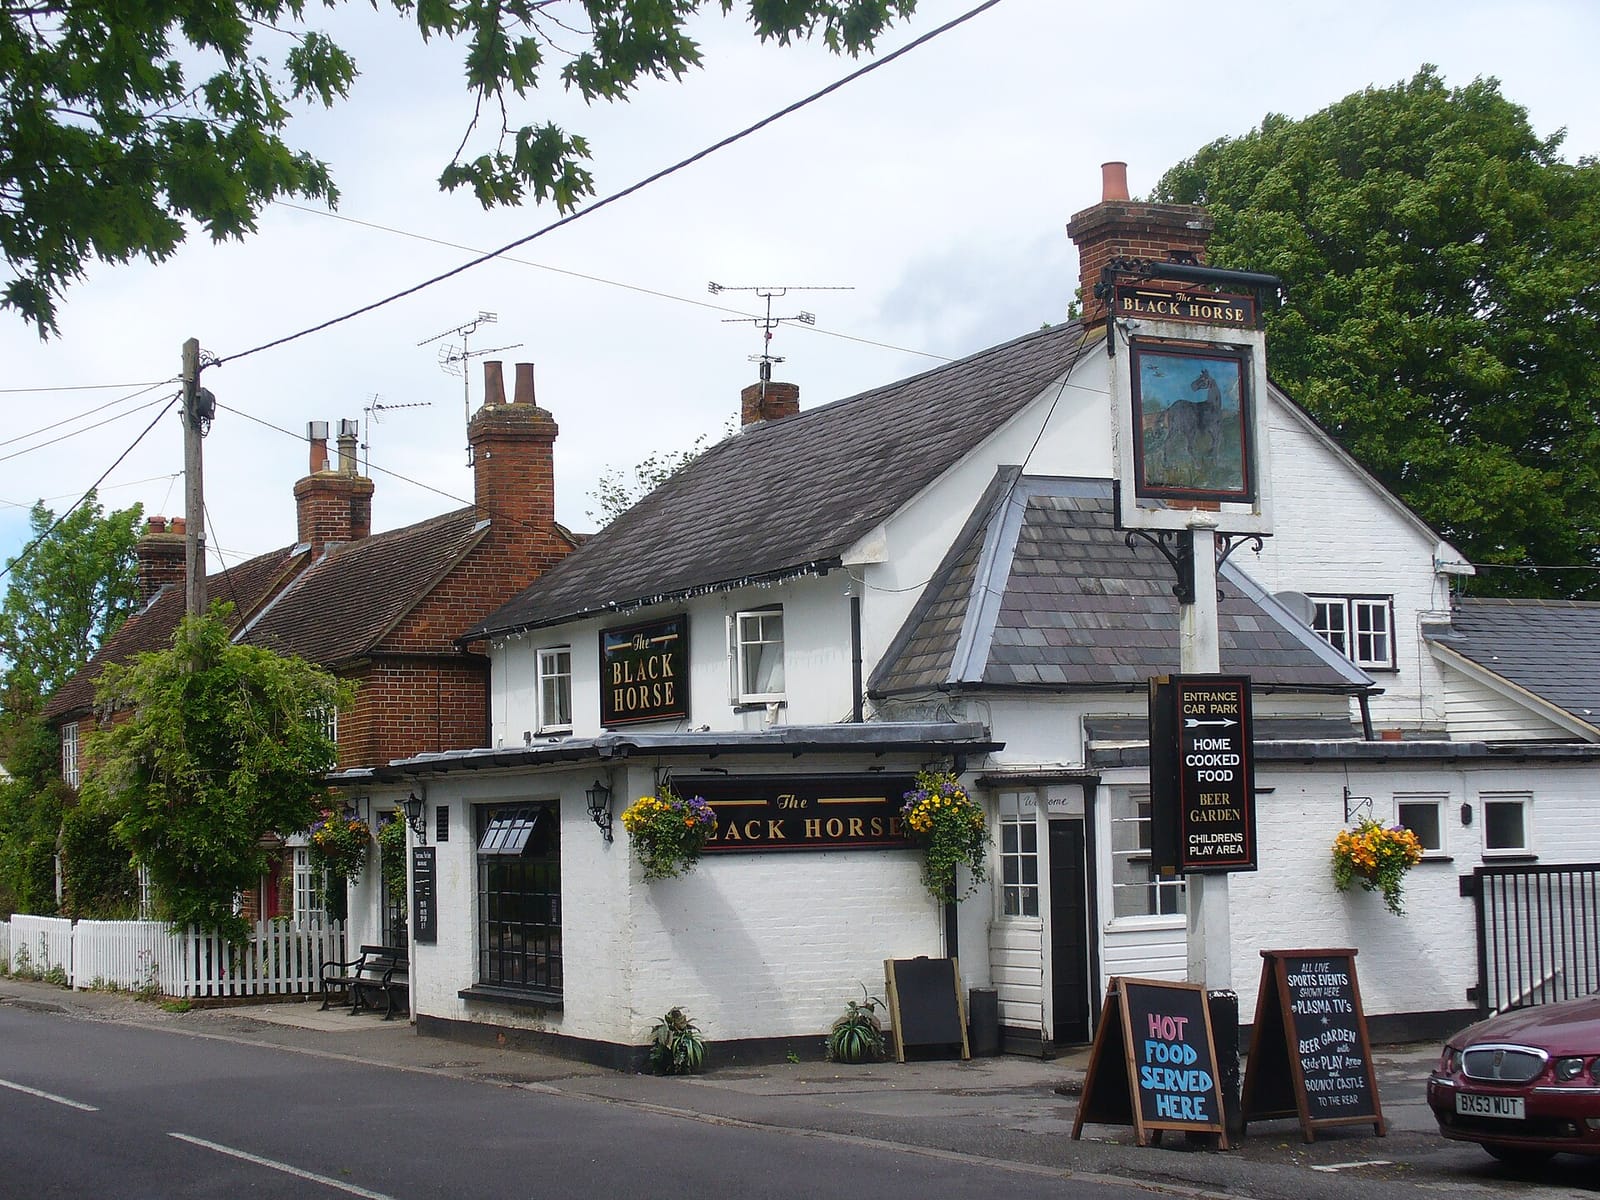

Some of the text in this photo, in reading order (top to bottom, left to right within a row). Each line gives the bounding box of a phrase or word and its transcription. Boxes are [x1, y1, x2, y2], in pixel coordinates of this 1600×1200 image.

[1176, 292, 1192, 302] The
[1124, 297, 1244, 322] BLACK HORSE
[633, 633, 650, 651] The
[613, 653, 674, 685] BLACK
[614, 681, 675, 712] HORSE
[1184, 692, 1238, 702] ENTRANCE
[1184, 704, 1238, 714] CAR PARK
[1194, 738, 1231, 750] HOME
[1186, 754, 1240, 767] COOKED
[1197, 770, 1234, 782] FOOD
[776, 794, 808, 809] The
[1200, 793, 1230, 806] BEER
[1190, 809, 1241, 822] GARDEN
[708, 820, 786, 840] ACK
[1189, 832, 1244, 844] CHILDRENS
[1189, 844, 1244, 856] PLAY AREA
[1301, 962, 1330, 972] ALL LIVE
[1288, 974, 1348, 986] SPORTS EVENTS
[1299, 986, 1340, 998] SHOWN HERE
[1297, 1000, 1332, 1014] PLASMA
[1148, 1014, 1188, 1041] HOT
[1300, 1028, 1356, 1054] BEER GARDEN
[1144, 1040, 1198, 1065] FOOD
[1320, 1056, 1342, 1070] PLAY
[1140, 1066, 1213, 1092] SERVED
[1304, 1076, 1364, 1092] BOUNCY CASTLE
[1156, 1094, 1208, 1120] HERE
[1318, 1094, 1359, 1106] TO THE REAR
[1461, 1095, 1490, 1113] BX53
